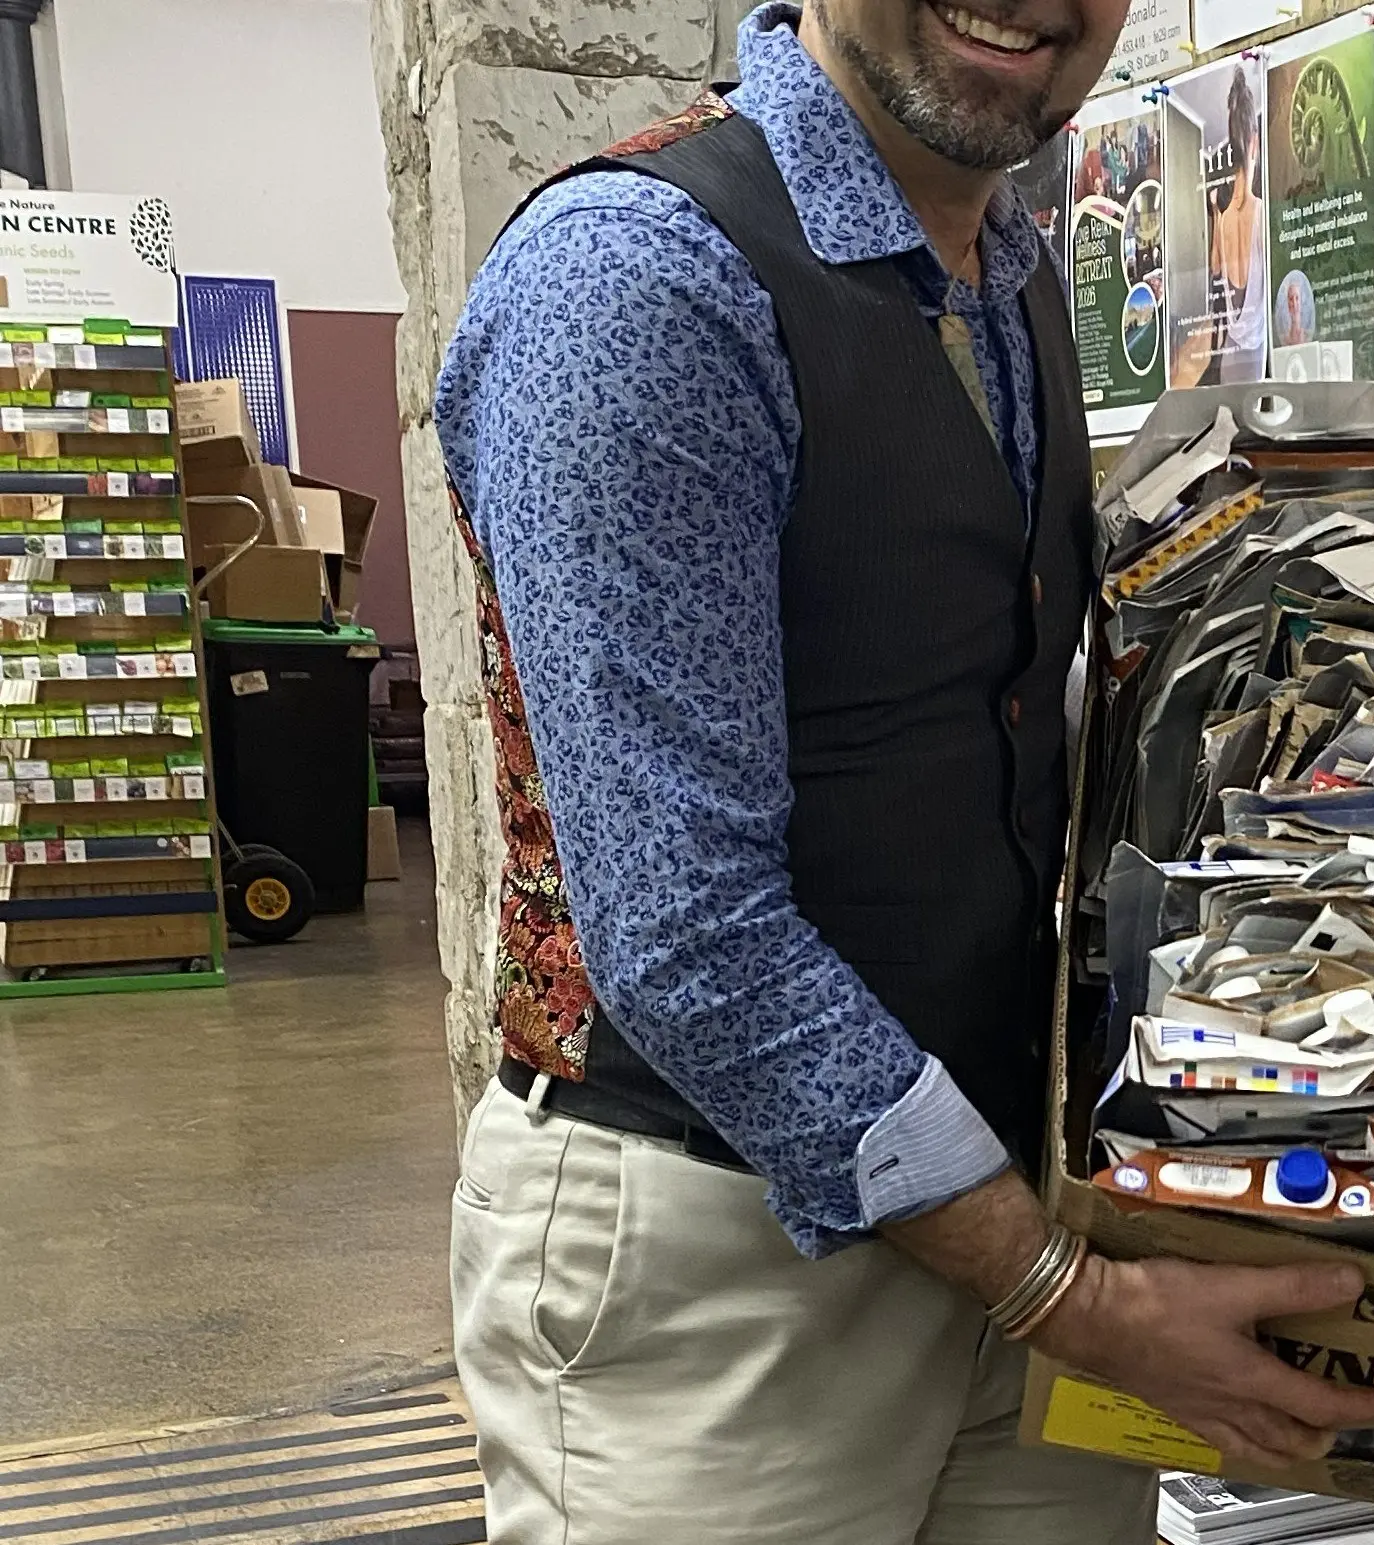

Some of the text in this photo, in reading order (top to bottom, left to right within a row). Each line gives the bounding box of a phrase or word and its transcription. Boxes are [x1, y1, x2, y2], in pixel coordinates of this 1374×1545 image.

[10, 199, 55, 210] Nature
[1282, 190, 1363, 221] Health and Wellbeing can be
[28, 216, 116, 235] CENTRE
[1307, 223, 1314, 237] by
[30, 243, 75, 258] Seeds
[1290, 246, 1301, 260] and
[1316, 238, 1332, 253] metal
[1076, 256, 1113, 285] RETREAT
